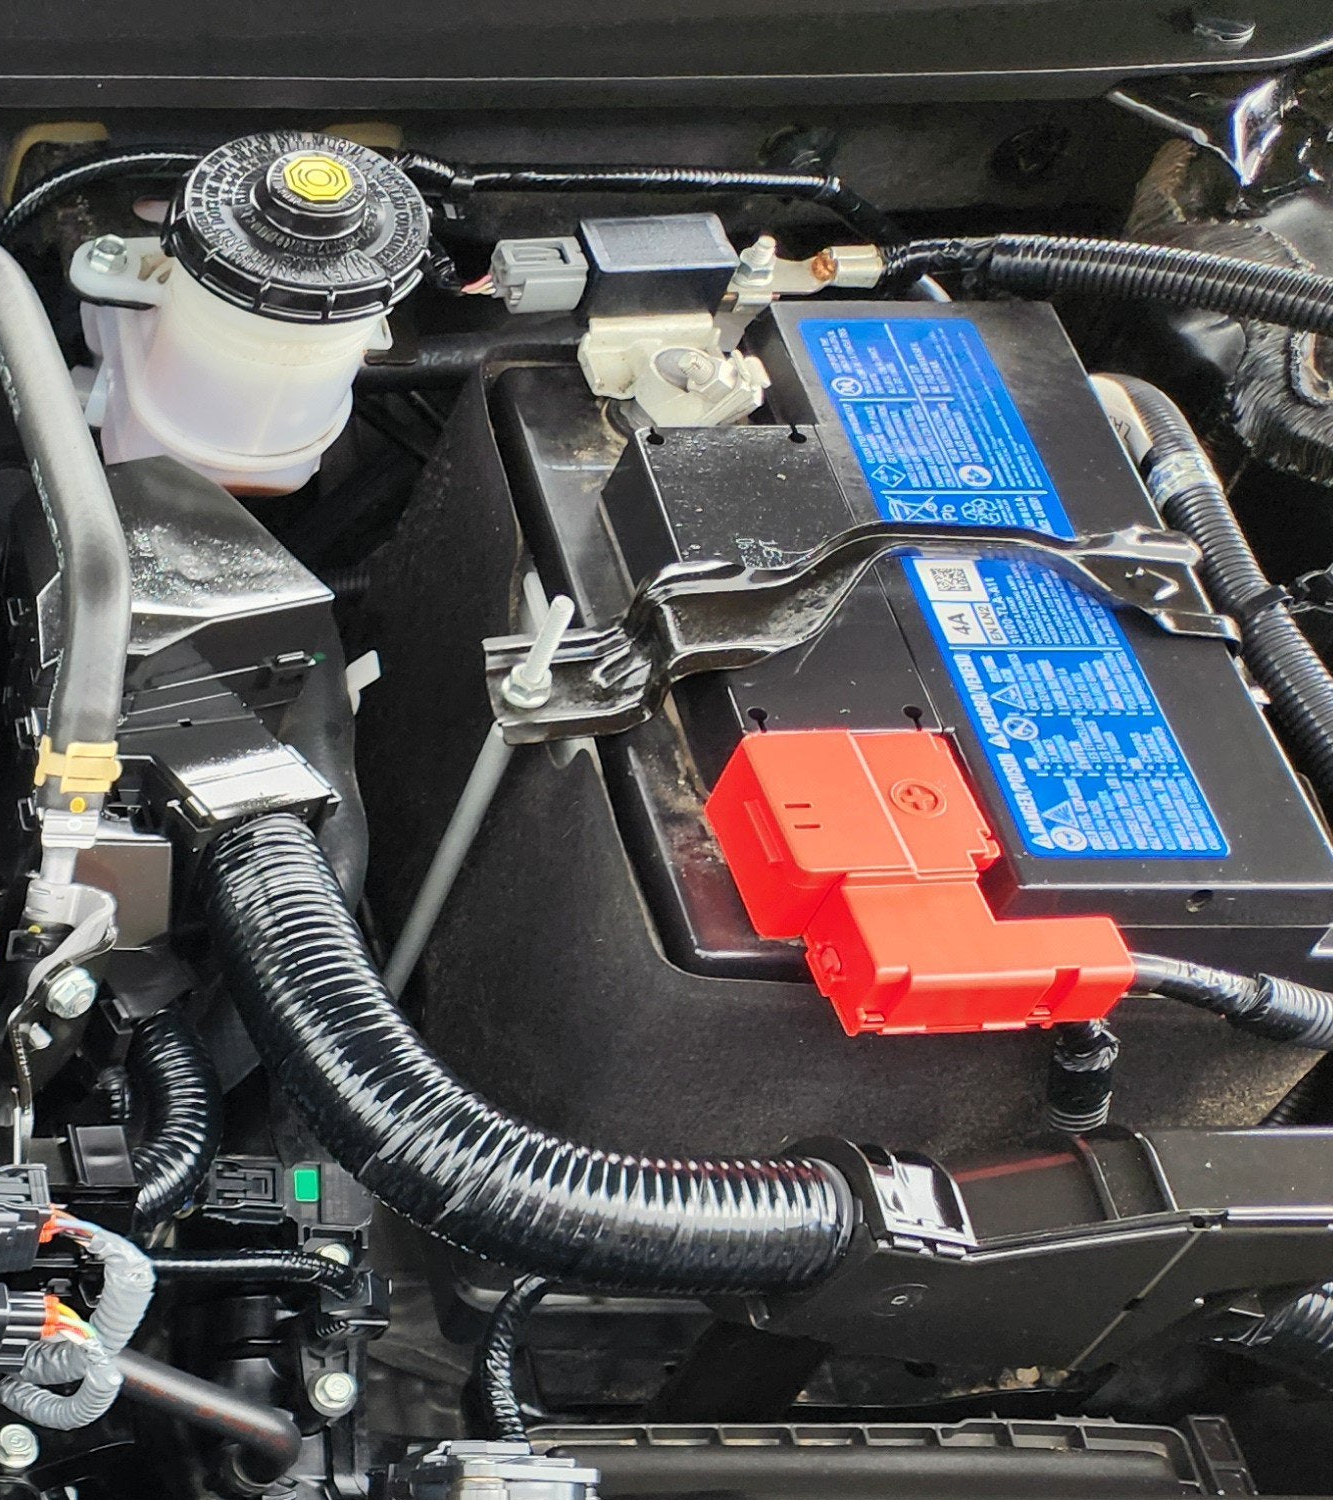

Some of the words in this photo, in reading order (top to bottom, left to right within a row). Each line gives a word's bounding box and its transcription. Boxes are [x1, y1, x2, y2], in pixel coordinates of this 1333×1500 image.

[944, 612, 974, 634] 4A
[975, 605, 997, 626] LN2
[986, 627, 1004, 641] EN
[994, 752, 1049, 834] DANGER/POISON
